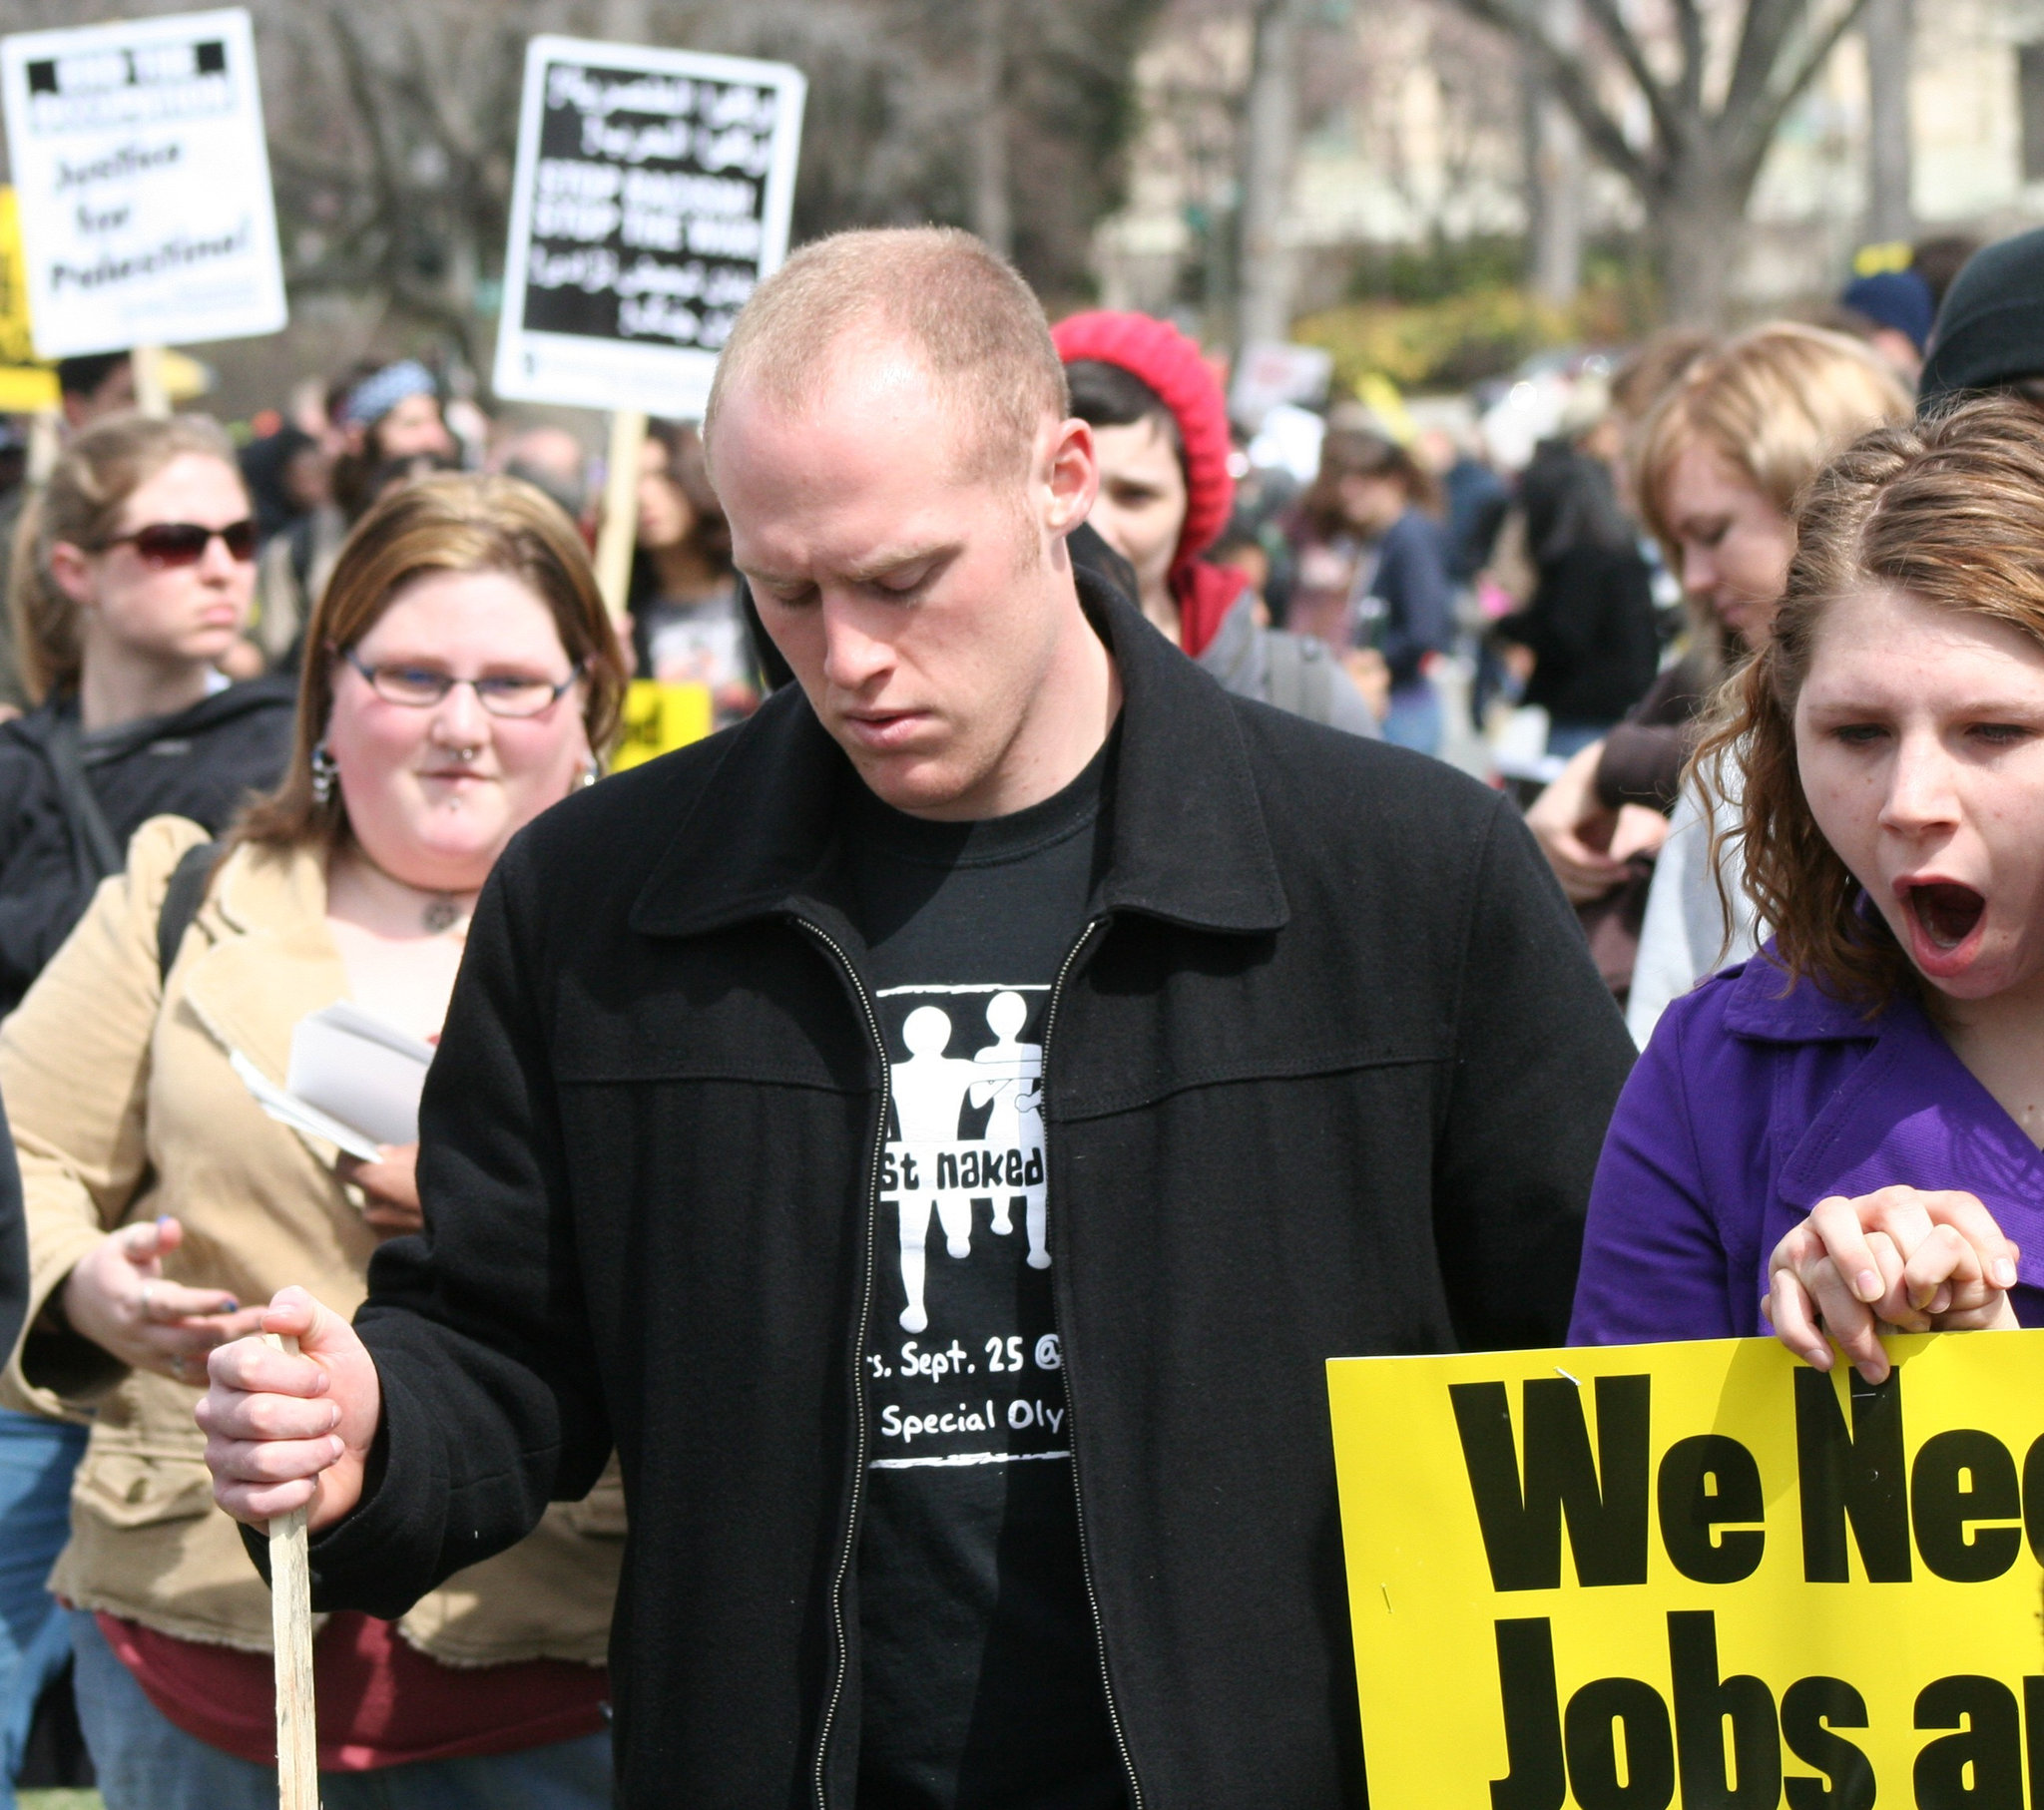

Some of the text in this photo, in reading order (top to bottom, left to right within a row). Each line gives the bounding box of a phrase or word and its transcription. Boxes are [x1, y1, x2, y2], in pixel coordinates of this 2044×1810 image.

[936, 1146, 1044, 1189] naked
[900, 1339, 976, 1384] Sept.
[985, 1335, 1024, 1373] 25
[1035, 1333, 1063, 1371] @
[881, 1399, 1065, 1444] Special Oly
[1448, 1365, 2044, 1592] We Ne
[1490, 1609, 2044, 1810] Jobs a
